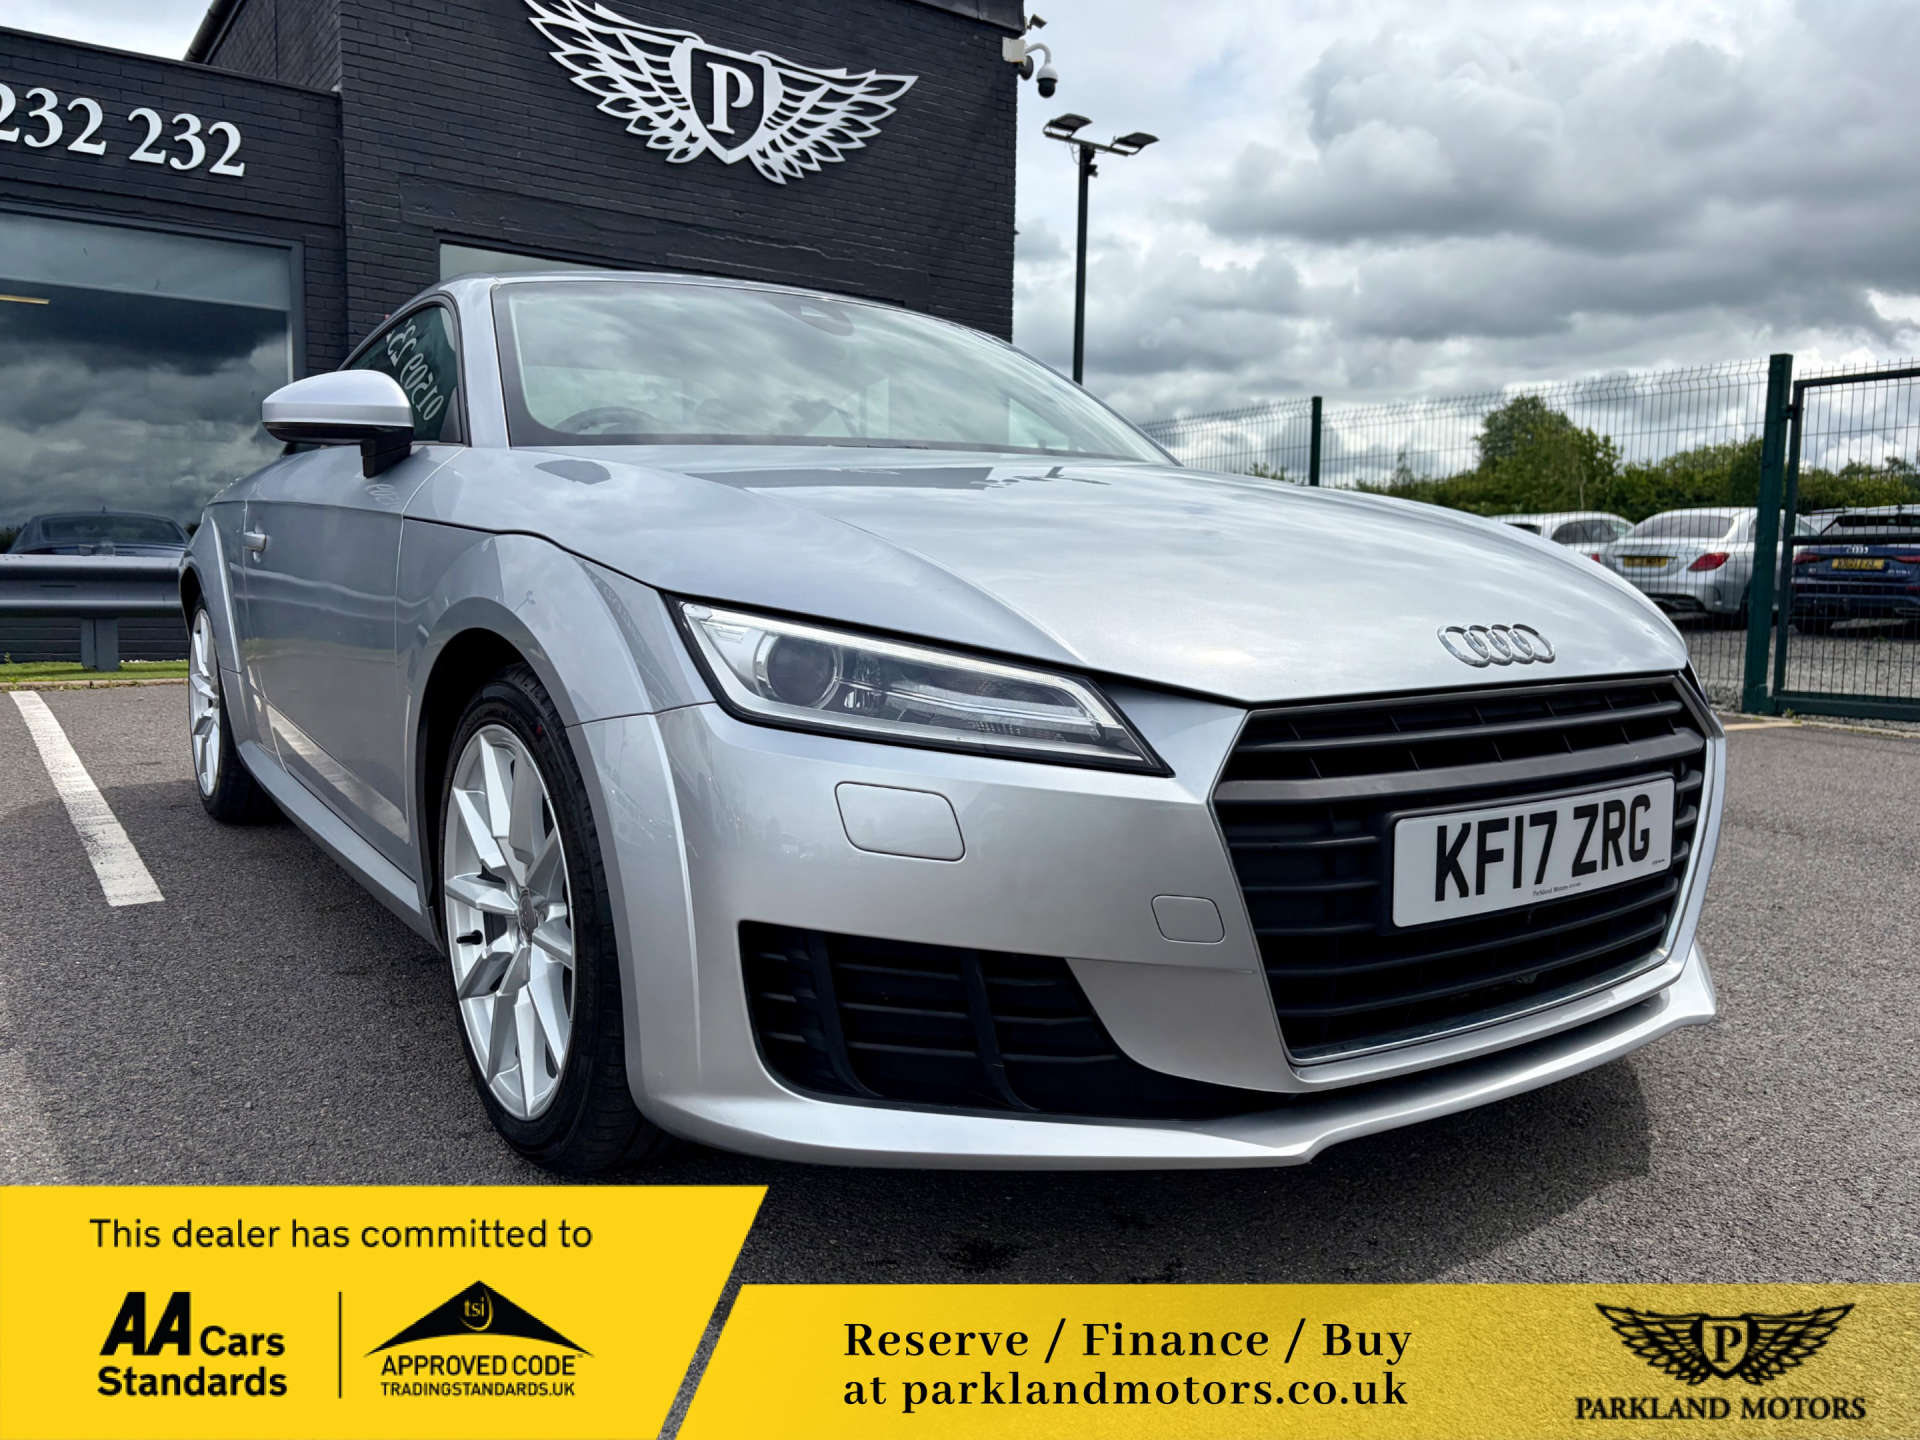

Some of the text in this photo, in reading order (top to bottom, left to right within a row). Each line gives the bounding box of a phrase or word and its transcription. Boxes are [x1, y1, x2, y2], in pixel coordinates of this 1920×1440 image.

[0, 82, 245, 177] 232 232
[705, 61, 754, 135] P
[1434, 794, 1652, 902] KF17 ZRG
